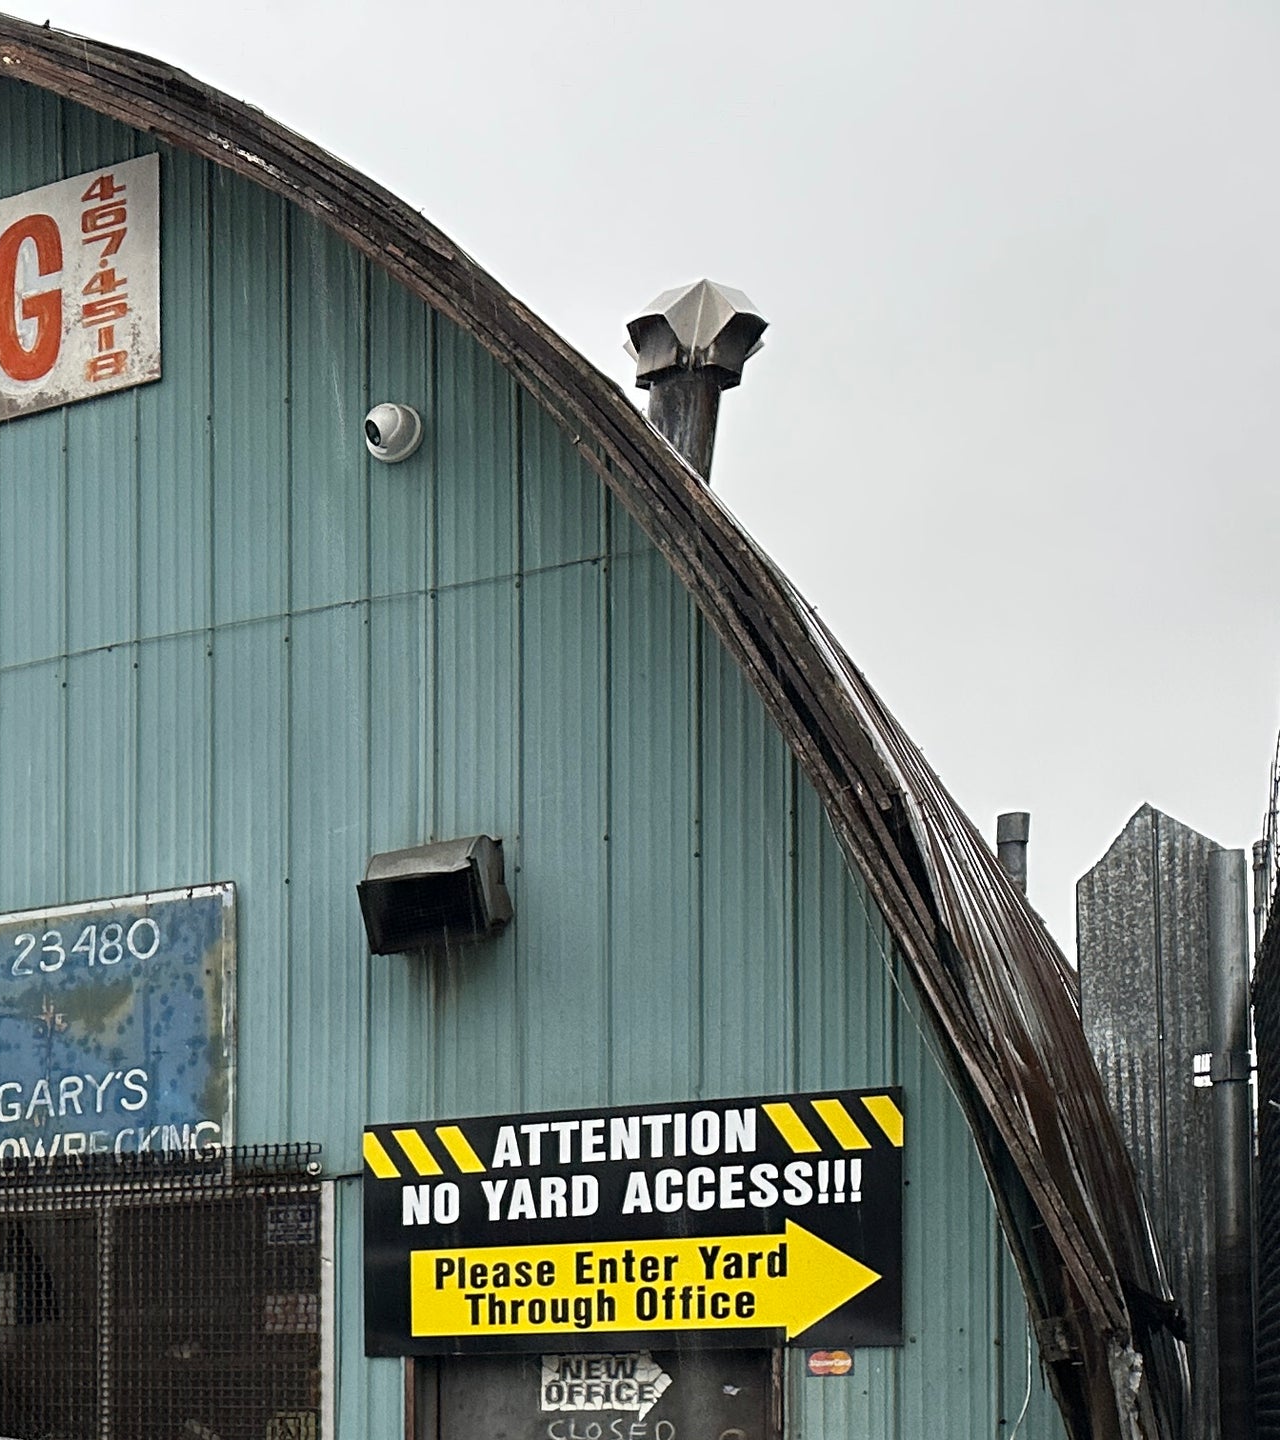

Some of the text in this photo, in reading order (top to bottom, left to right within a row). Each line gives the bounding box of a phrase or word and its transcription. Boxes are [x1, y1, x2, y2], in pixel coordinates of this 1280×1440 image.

[11, 917, 161, 976] 23480
[491, 1107, 758, 1169] ATTENTION
[401, 1158, 863, 1226] NO YARD ACCESS!!!
[434, 1242, 789, 1291] Please Enter Yard
[464, 1285, 757, 1330] Through Office
[545, 1380, 655, 1404] OFFICE
[559, 1357, 638, 1381] NEW
